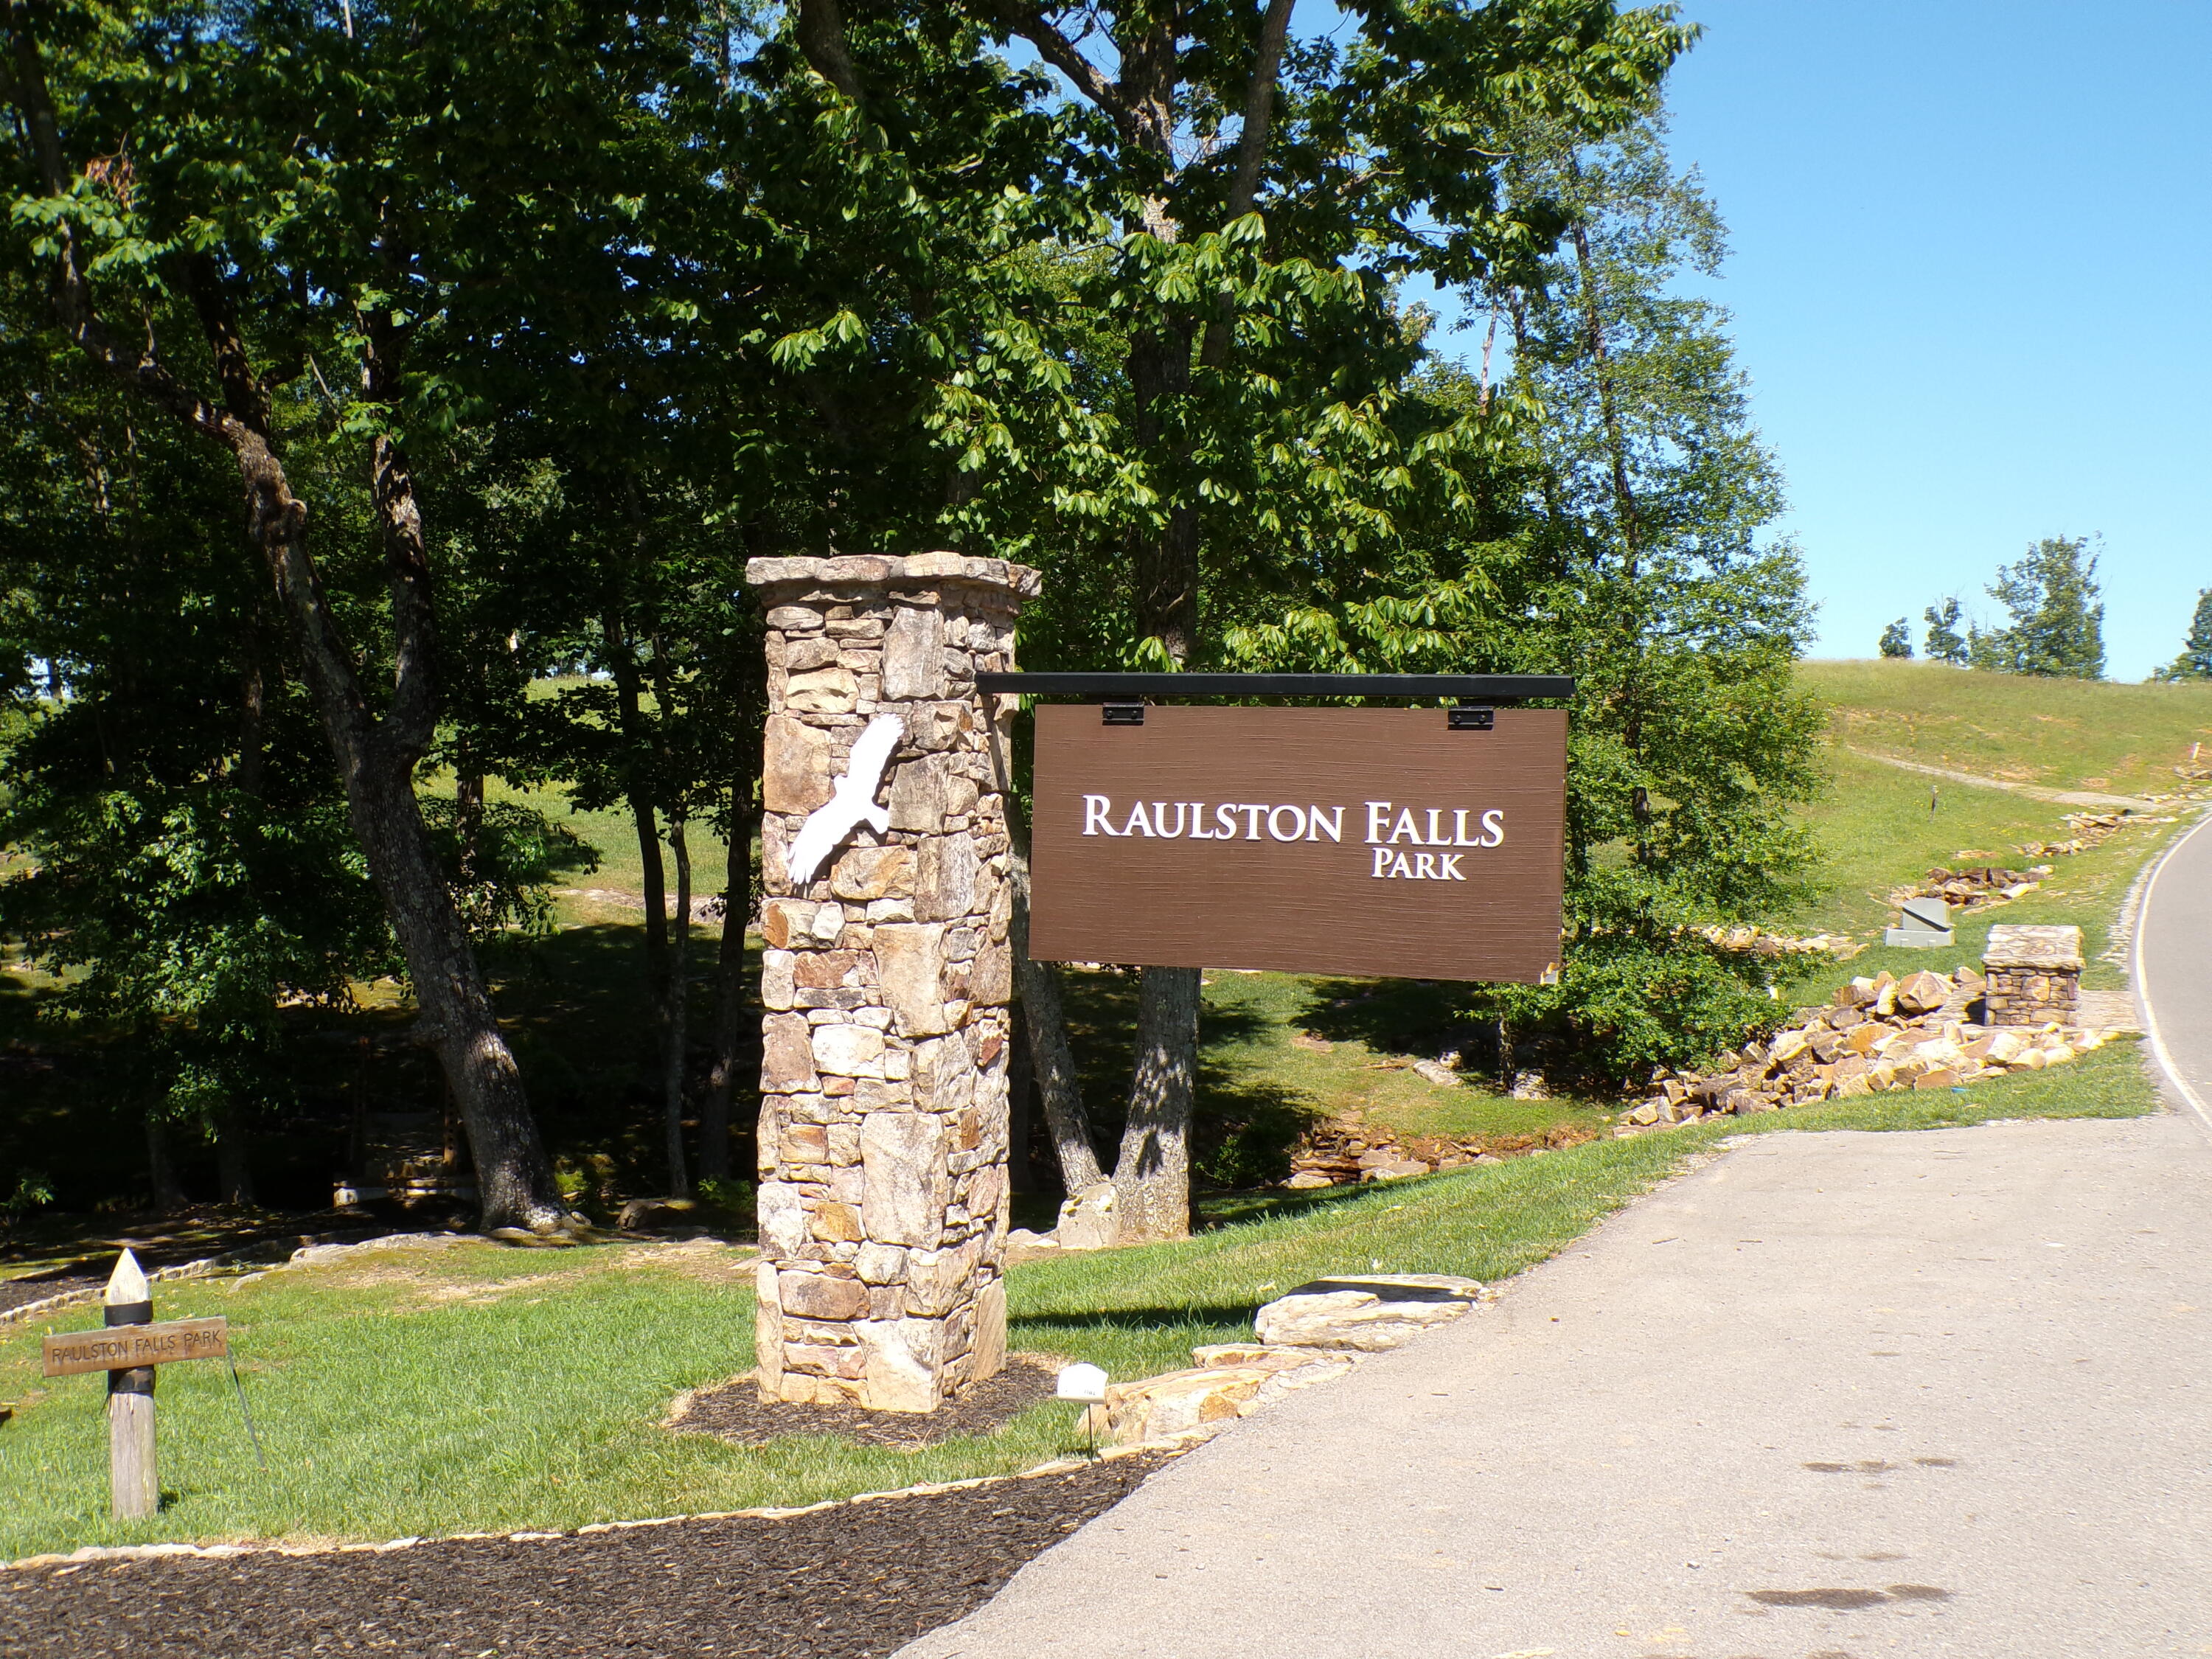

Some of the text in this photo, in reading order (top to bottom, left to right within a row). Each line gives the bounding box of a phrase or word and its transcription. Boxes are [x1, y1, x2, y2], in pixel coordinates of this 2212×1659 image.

[1082, 795, 1504, 848] RAULSTON FALLS
[1371, 847, 1467, 881] PARK
[52, 1329, 220, 1363] RAULSTON FALLS PARK
